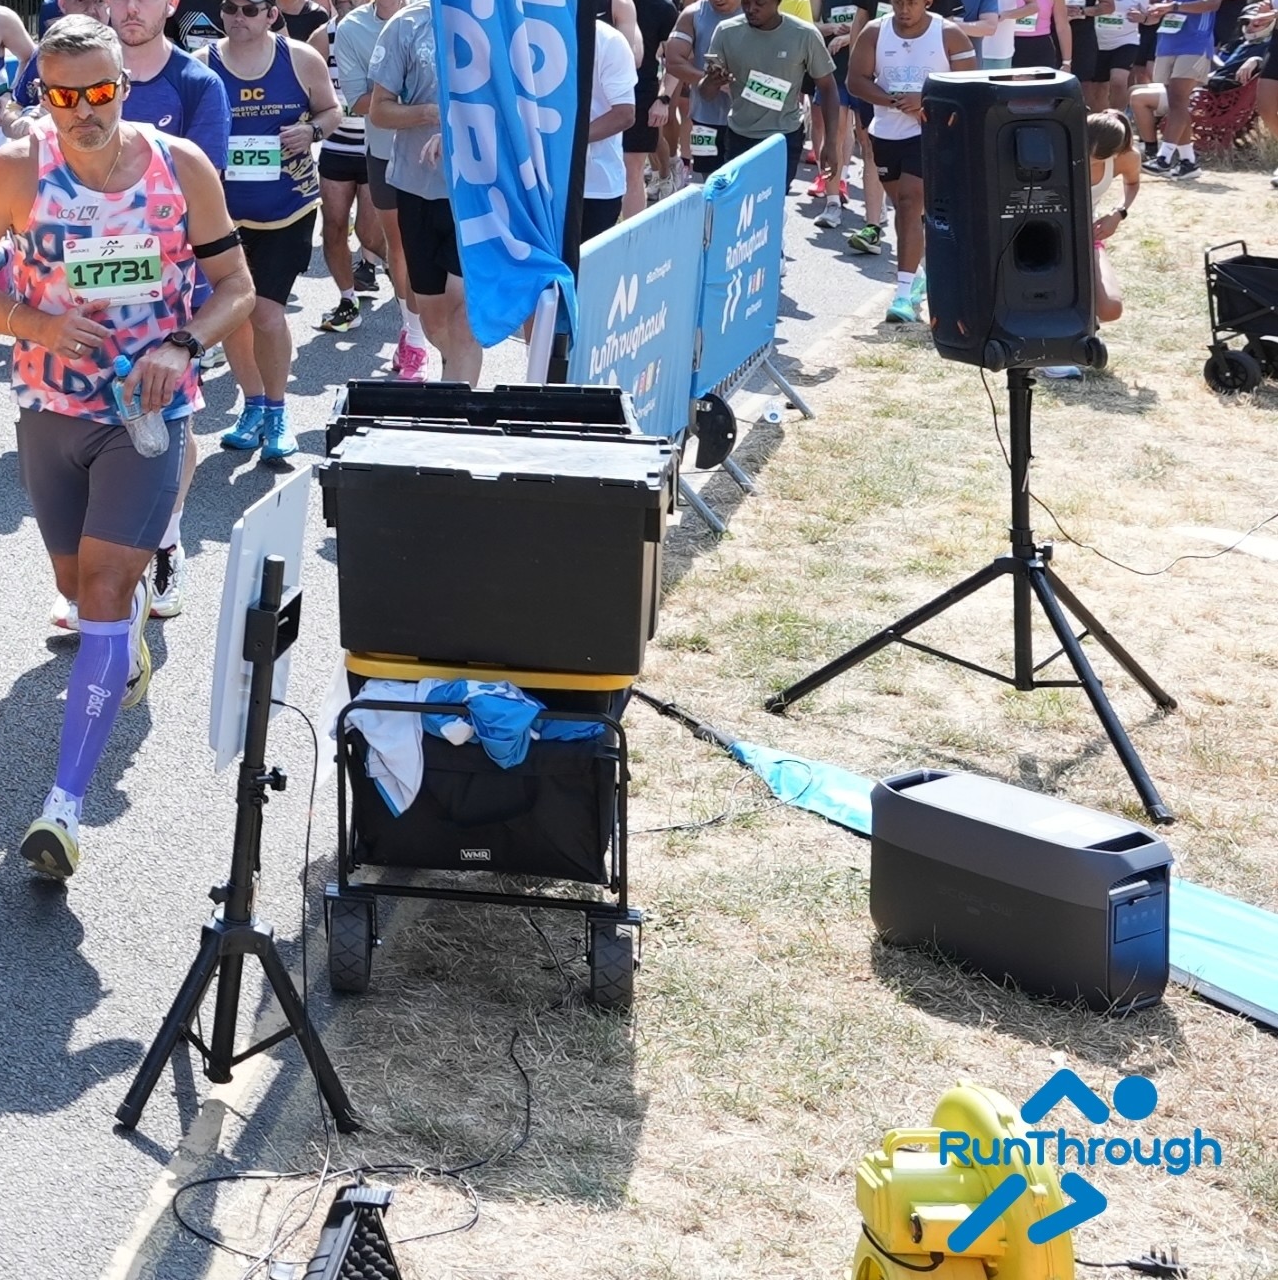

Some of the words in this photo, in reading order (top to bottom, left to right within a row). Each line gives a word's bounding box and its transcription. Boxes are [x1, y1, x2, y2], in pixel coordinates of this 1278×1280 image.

[240, 87, 265, 101] DC
[232, 150, 271, 166] 875
[73, 259, 154, 287] 17731
[461, 849, 490, 861] WMR
